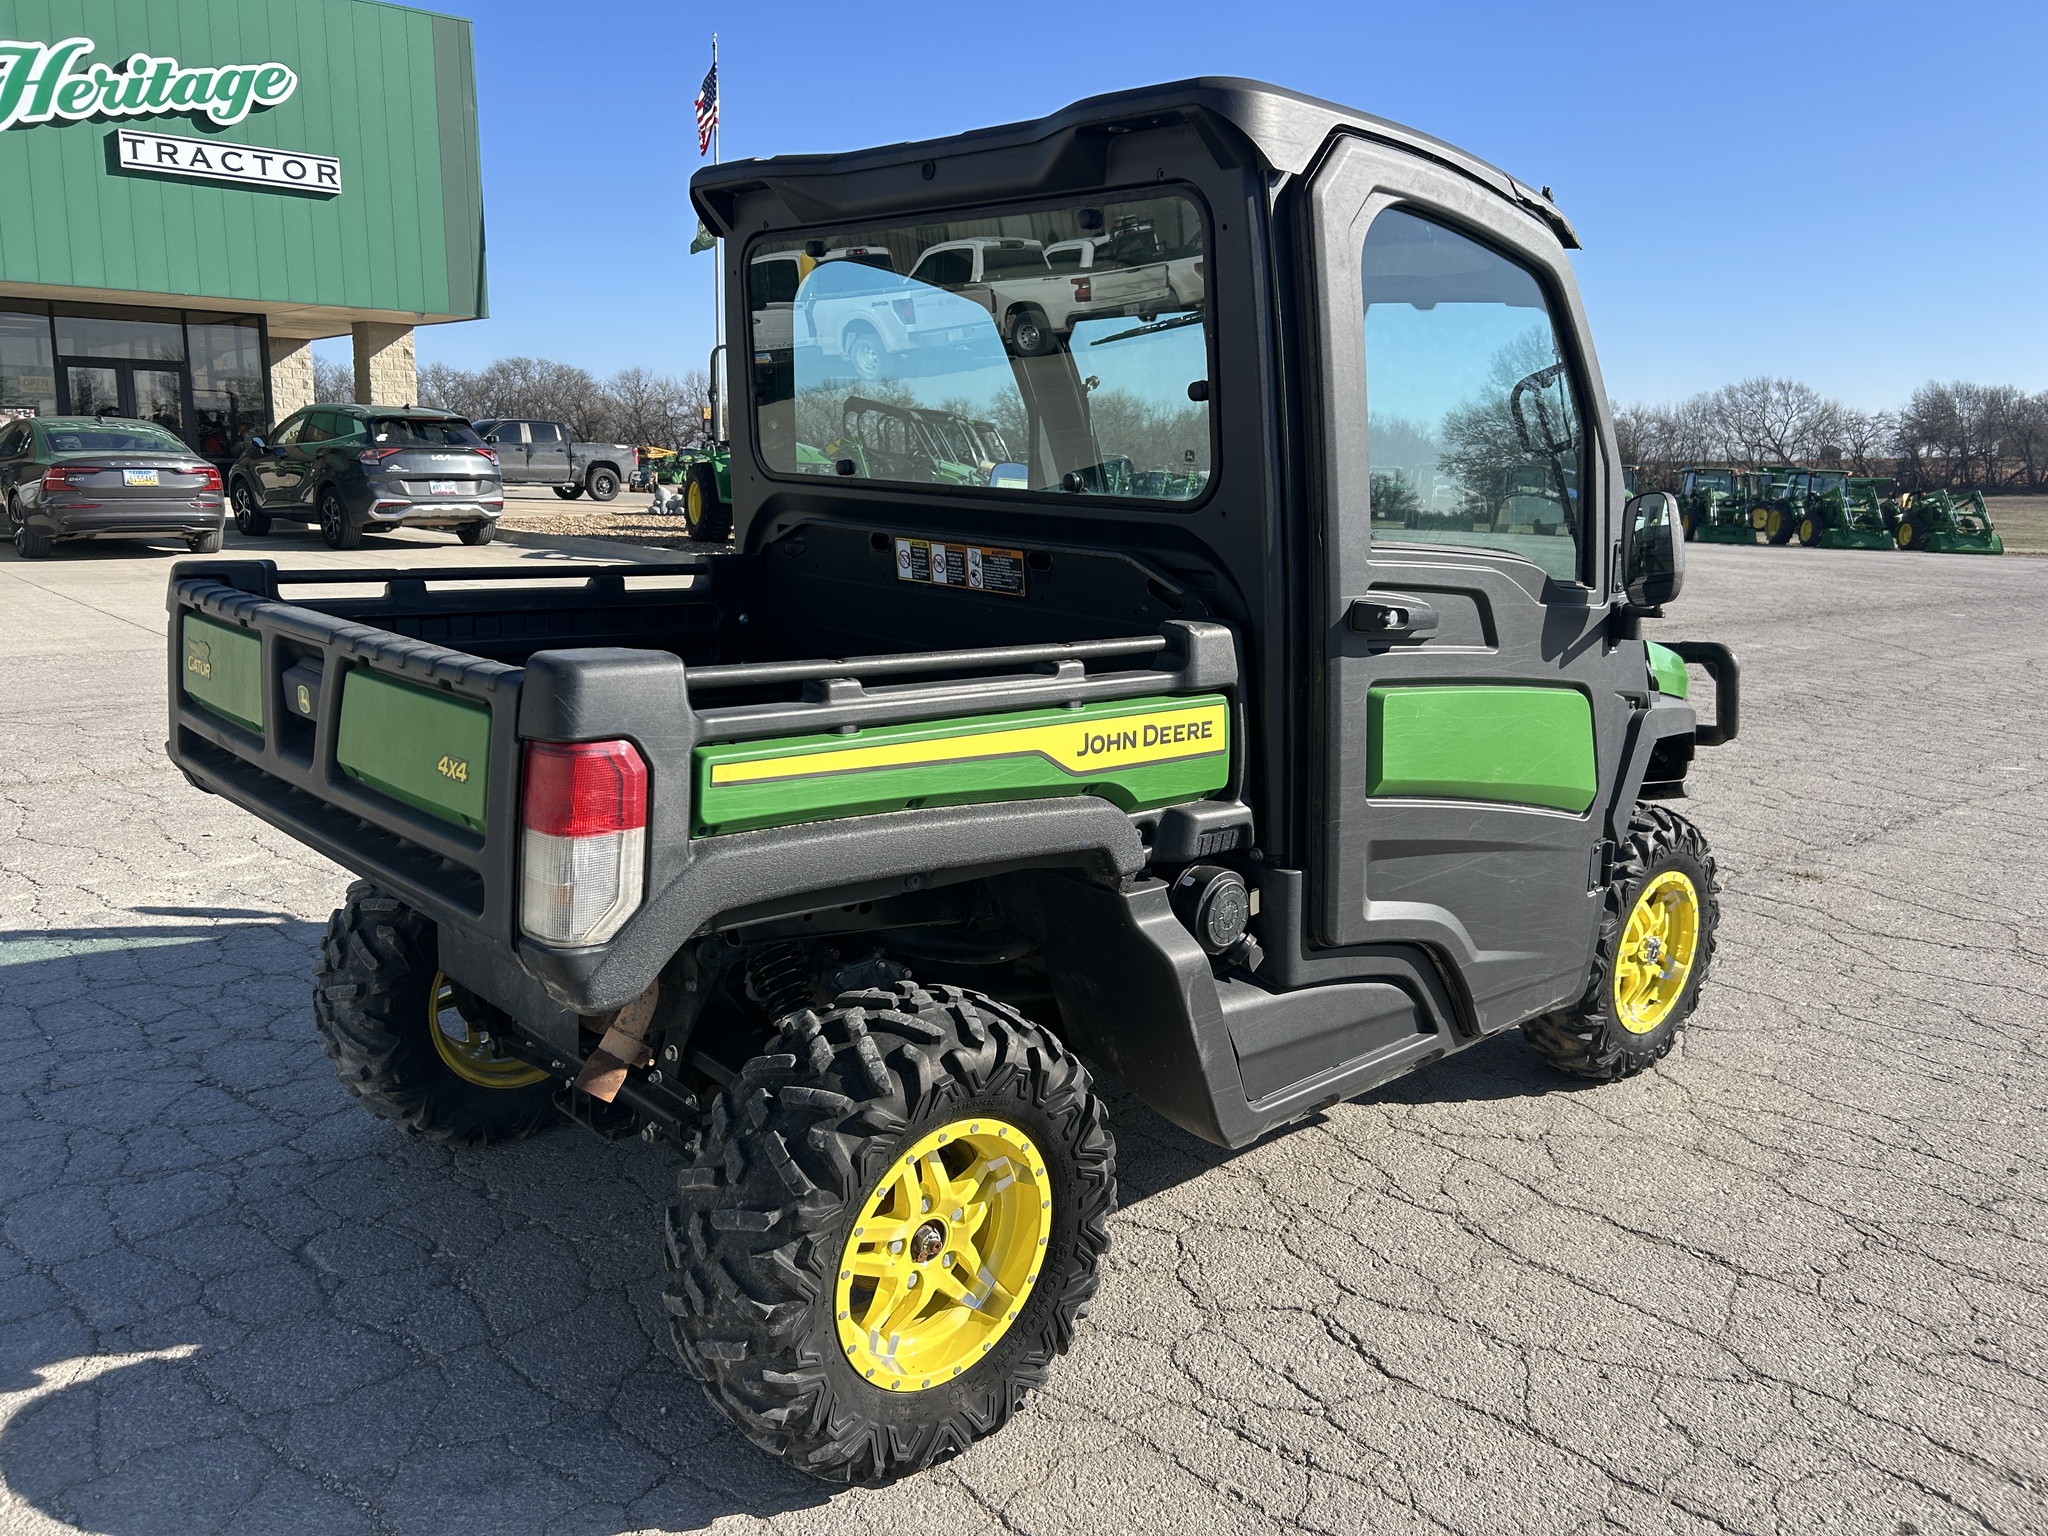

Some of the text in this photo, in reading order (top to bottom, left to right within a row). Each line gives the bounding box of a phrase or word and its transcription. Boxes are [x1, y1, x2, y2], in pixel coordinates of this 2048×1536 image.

[0, 37, 298, 129] Heritage
[122, 137, 339, 186] TRACTOR
[187, 654, 211, 679] GATOR
[1076, 720, 1213, 757] JOHN DEERE
[992, 1240, 1071, 1376] BIGHORN
